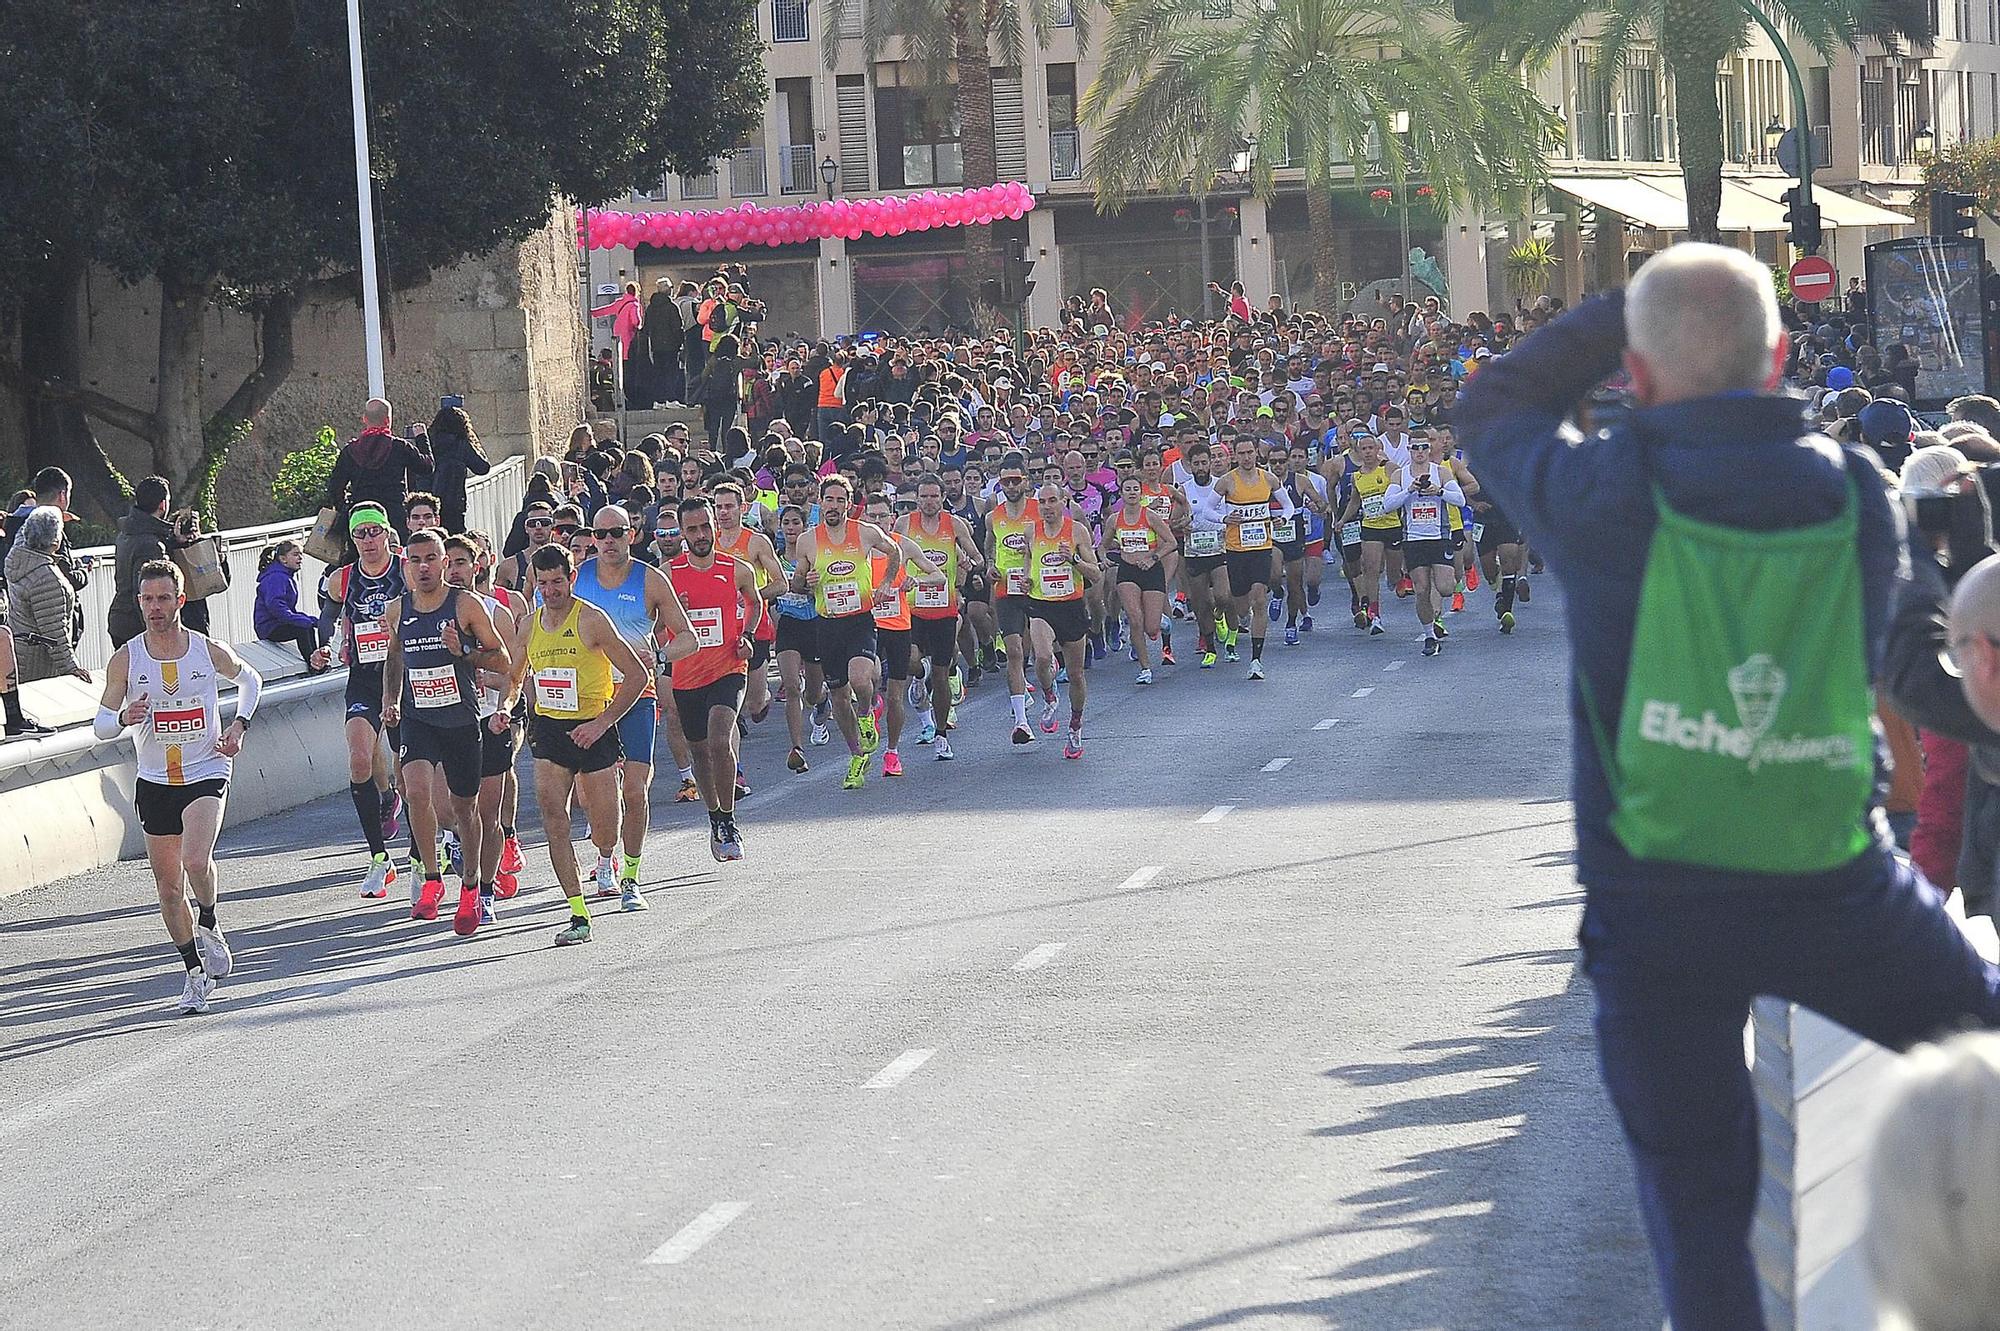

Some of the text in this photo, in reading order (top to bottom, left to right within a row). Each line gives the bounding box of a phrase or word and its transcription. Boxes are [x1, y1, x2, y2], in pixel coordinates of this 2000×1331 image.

[618, 593, 636, 602] HOKA
[836, 598, 848, 607] 31
[415, 684, 455, 698] 5025
[546, 689, 564, 699] 55
[156, 718, 203, 732] 5030
